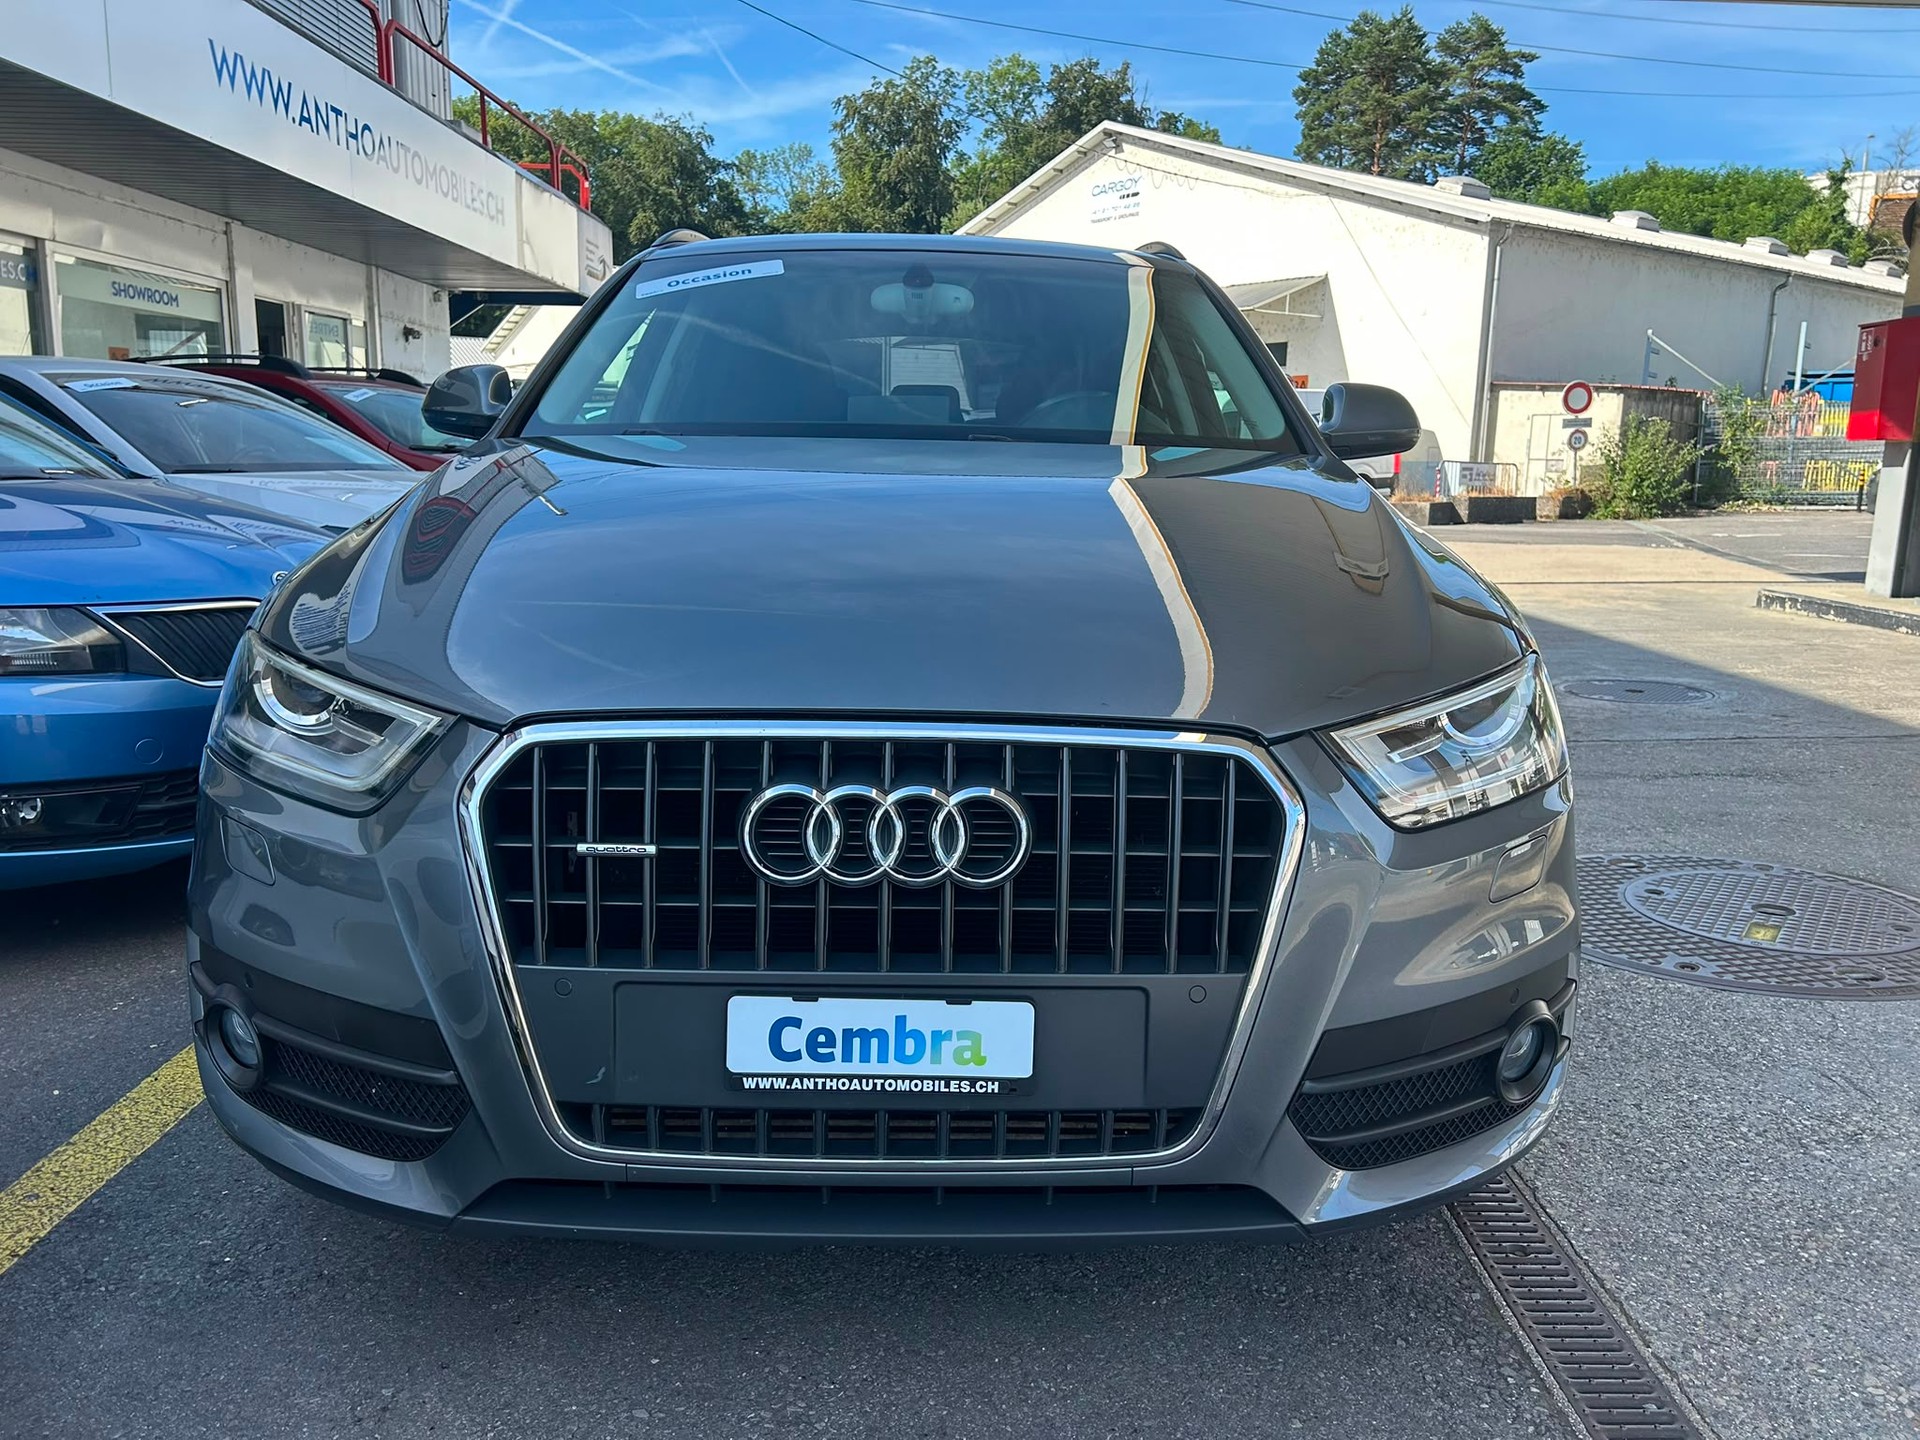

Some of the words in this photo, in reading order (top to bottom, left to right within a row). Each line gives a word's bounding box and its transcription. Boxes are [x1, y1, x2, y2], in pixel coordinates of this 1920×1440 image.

[208, 37, 505, 227] WWW.ANTHOAUTOMOBILES.CH
[1091, 175, 1143, 197] CARGOY
[667, 268, 752, 288] Occasion
[111, 281, 180, 308] SHOWROOM
[1573, 436, 1582, 445] 20
[586, 846, 647, 854] quattro
[768, 1014, 987, 1067] Cembra
[742, 1077, 999, 1094] WWW.ANTHOAUTOMOBILES.CH
